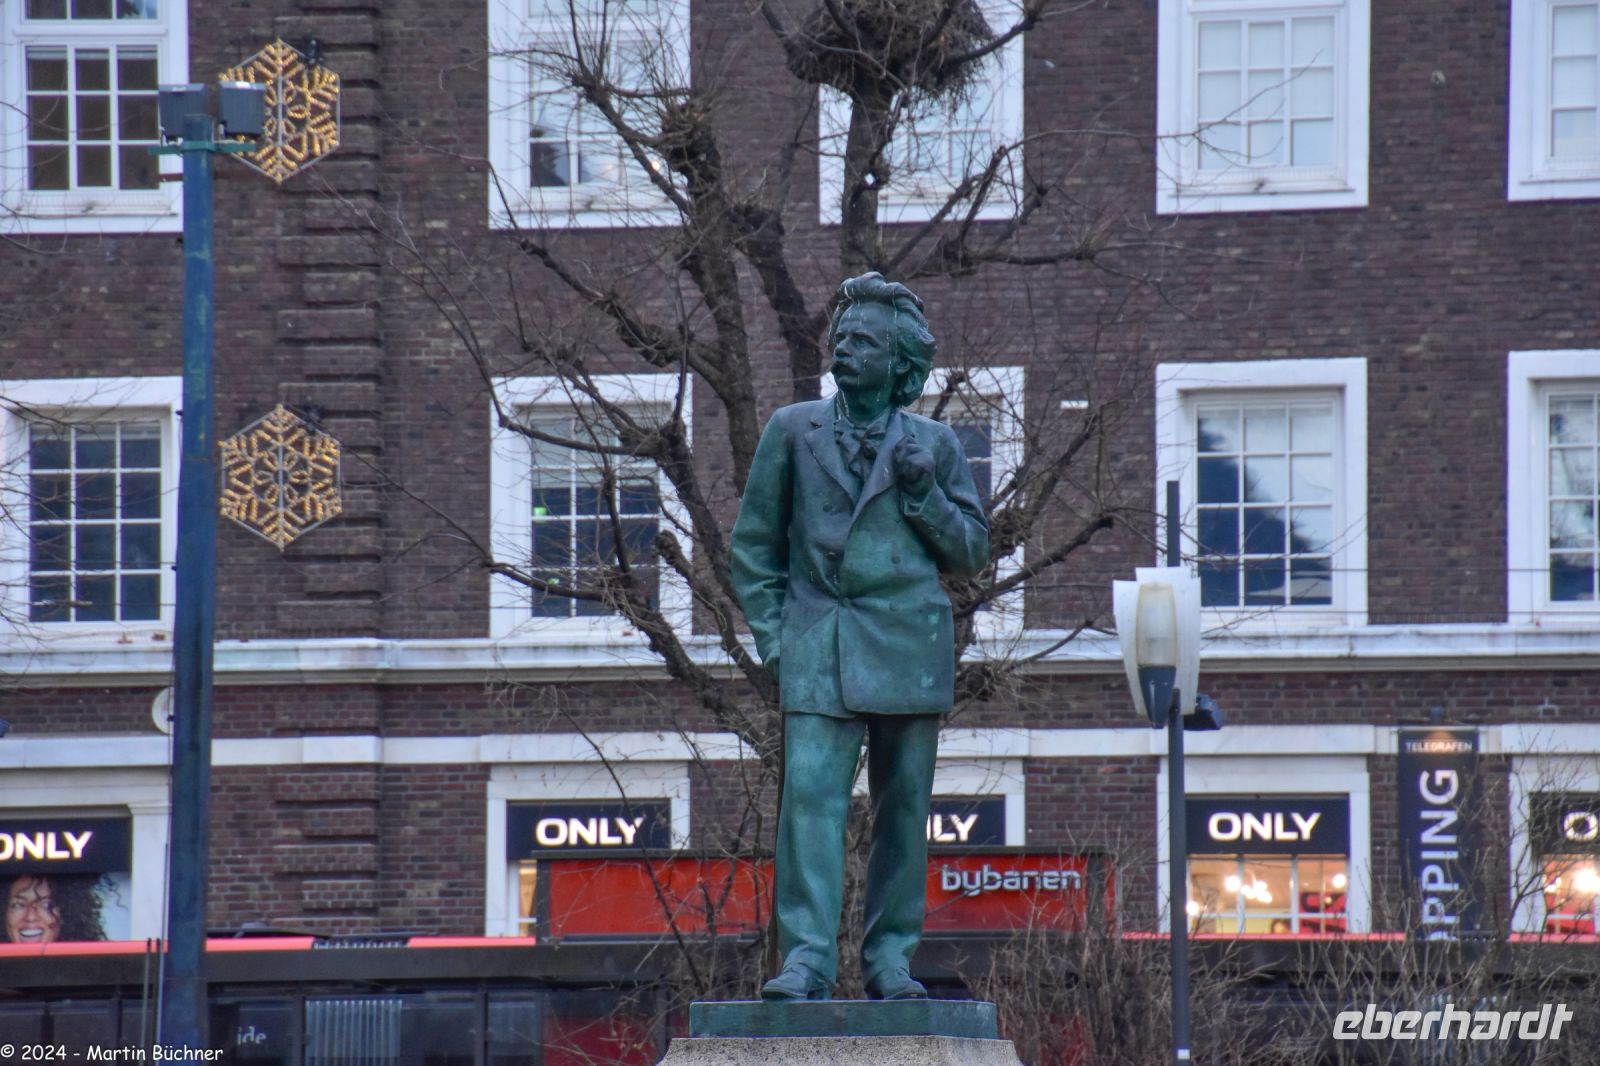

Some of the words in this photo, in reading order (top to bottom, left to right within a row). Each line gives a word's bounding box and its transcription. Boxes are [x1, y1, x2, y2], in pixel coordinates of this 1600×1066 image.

[1405, 741, 1472, 753] TELEGRAFEN
[536, 817, 644, 845] ONLY
[926, 813, 979, 841] LY
[1208, 811, 1321, 841] ONLY
[1419, 769, 1459, 941] PPING
[941, 863, 1082, 897] bybanen
